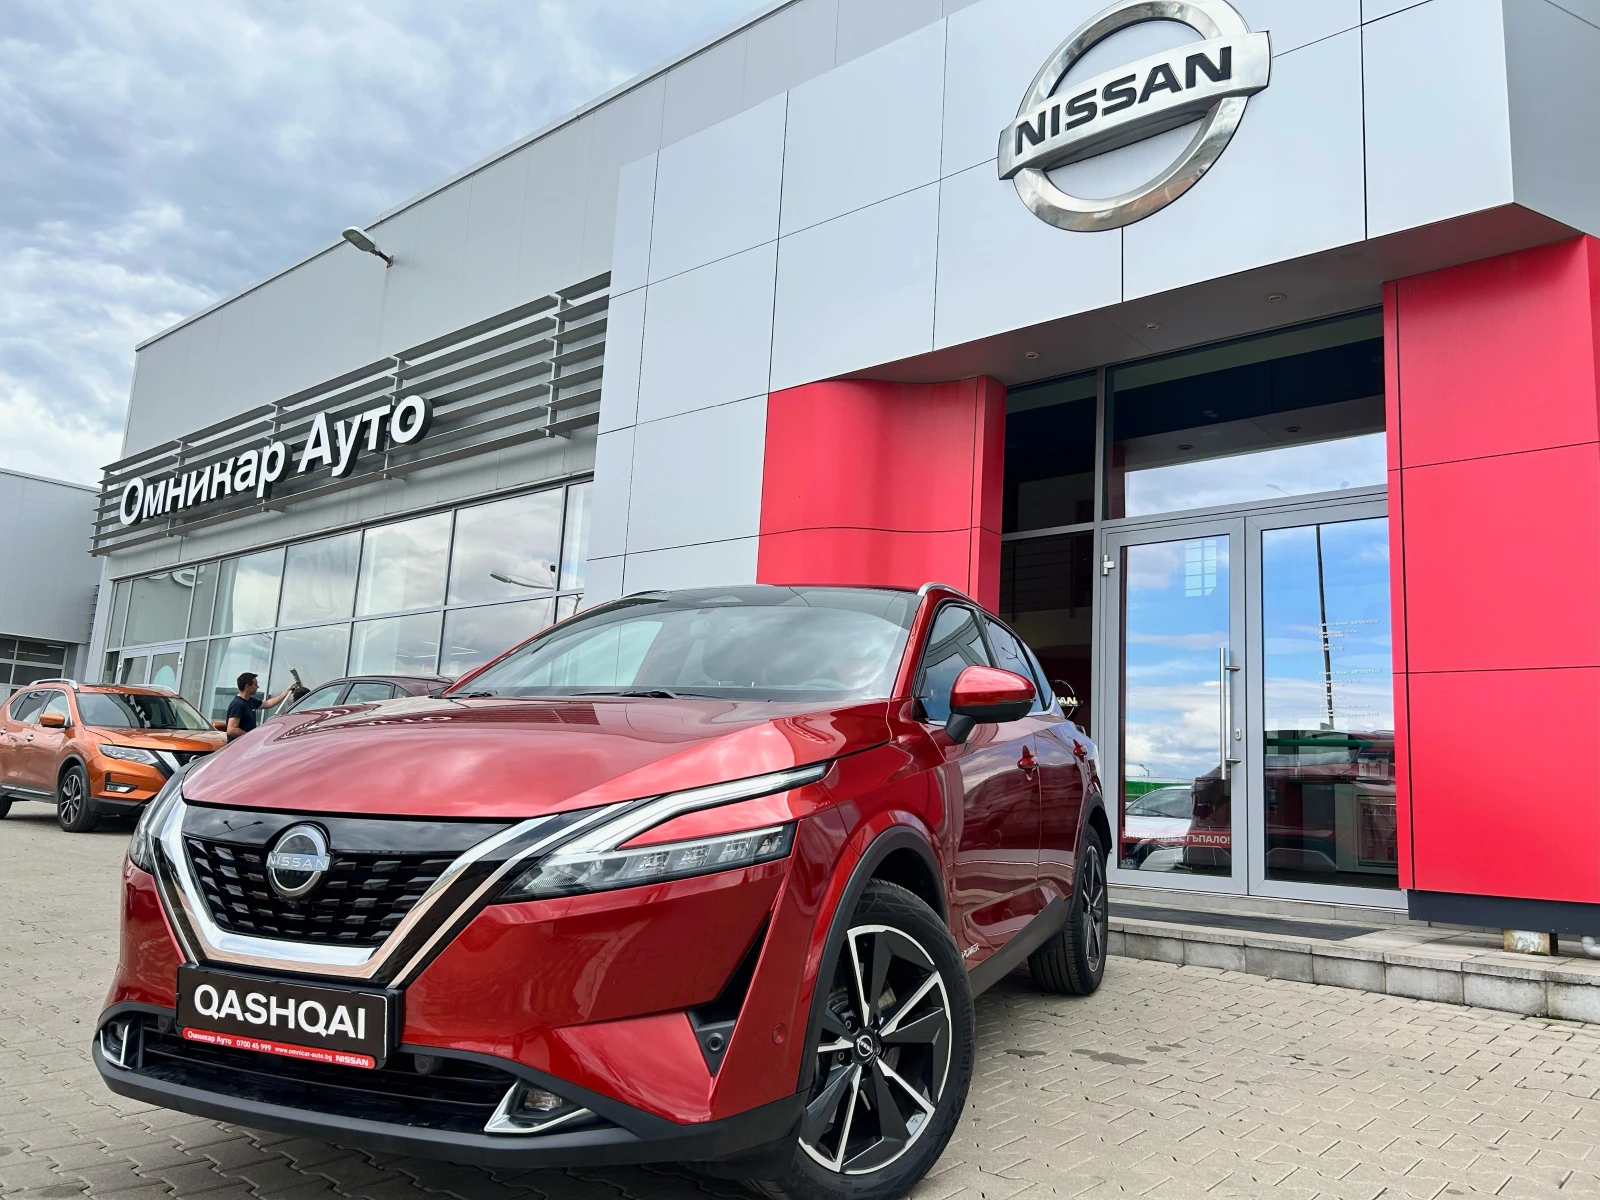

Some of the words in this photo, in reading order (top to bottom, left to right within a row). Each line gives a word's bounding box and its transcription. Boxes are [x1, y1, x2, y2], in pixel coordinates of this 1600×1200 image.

[1015, 46, 1232, 156] NISSAN
[120, 441, 287, 526] Омникар
[297, 395, 428, 478] Ауто
[268, 856, 328, 868] NISSAN
[194, 984, 366, 1040] QASHQAI
[216, 1036, 232, 1045] Ауто
[236, 1039, 251, 1048] 0700
[260, 1043, 271, 1051] 999
[274, 1046, 332, 1061] www.omnicar-auto.bg
[335, 1055, 368, 1066] NISSAN
